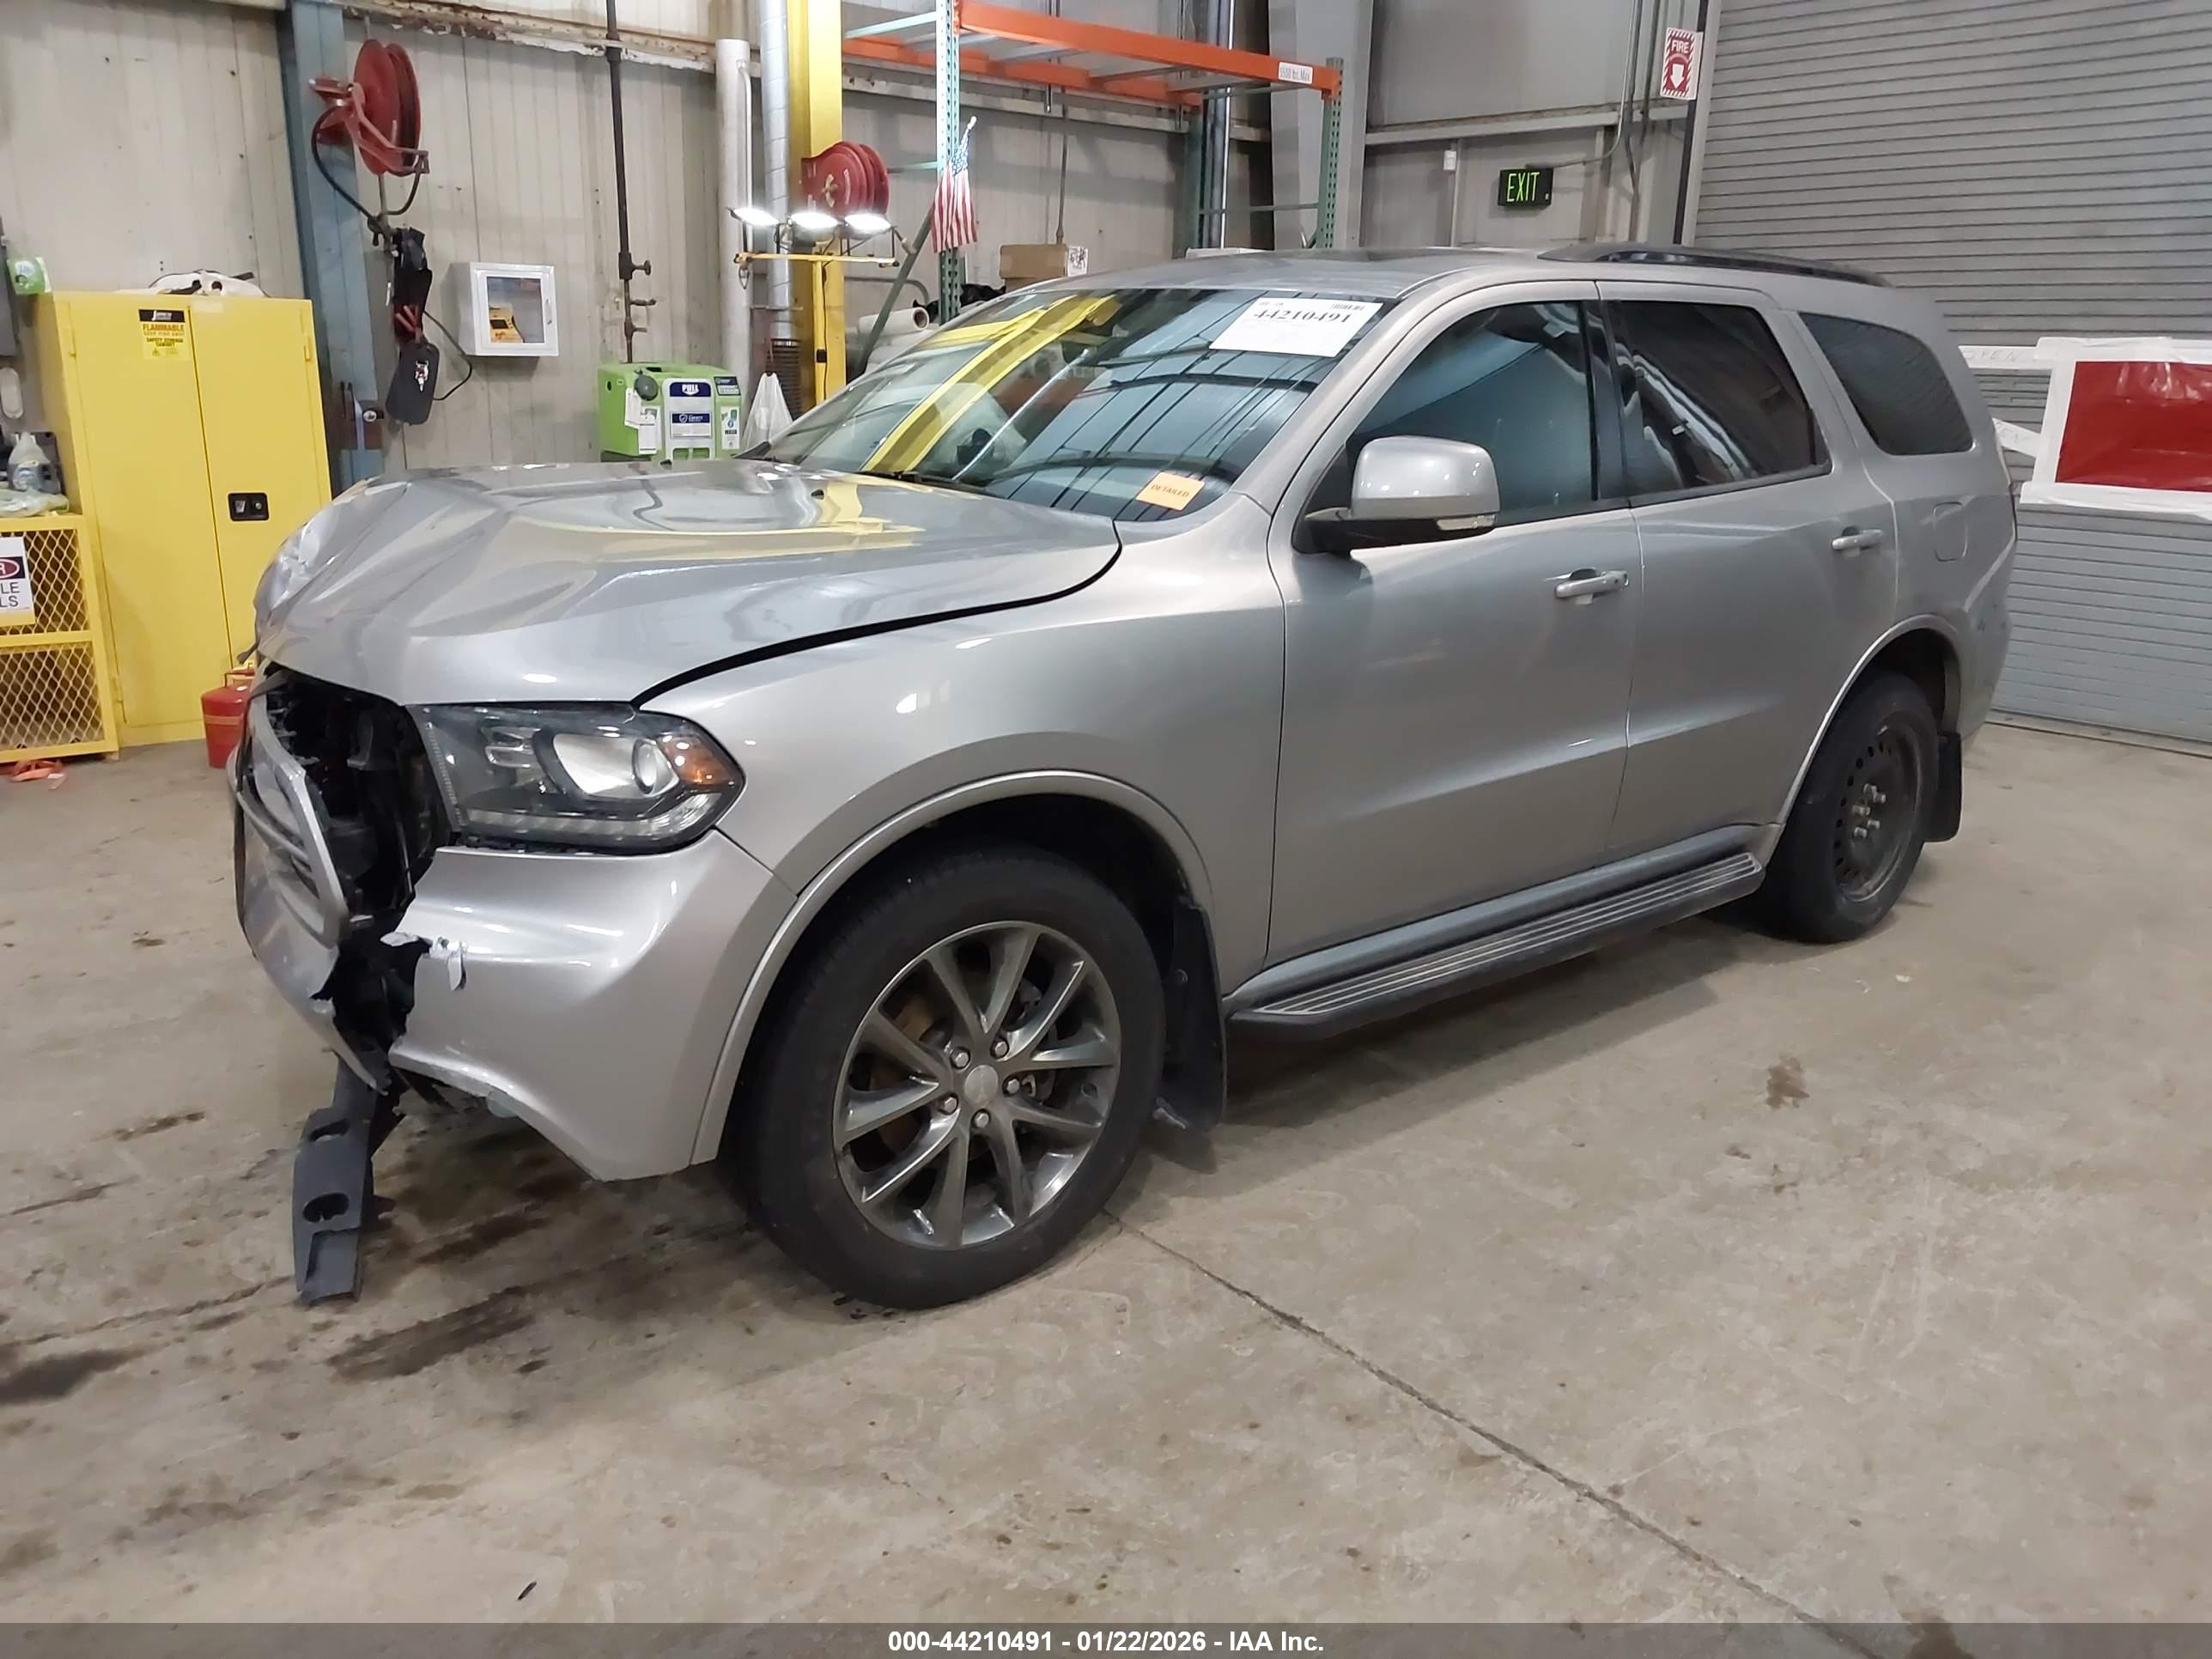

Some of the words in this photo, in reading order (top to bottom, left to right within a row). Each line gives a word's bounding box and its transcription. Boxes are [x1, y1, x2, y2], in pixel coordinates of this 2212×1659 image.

[1671, 40, 1690, 53] FIRE
[1506, 171, 1540, 202] EXIT
[1253, 309, 1352, 323] 44210491
[681, 384, 700, 393] PULL
[1151, 483, 1190, 498] DETAILED
